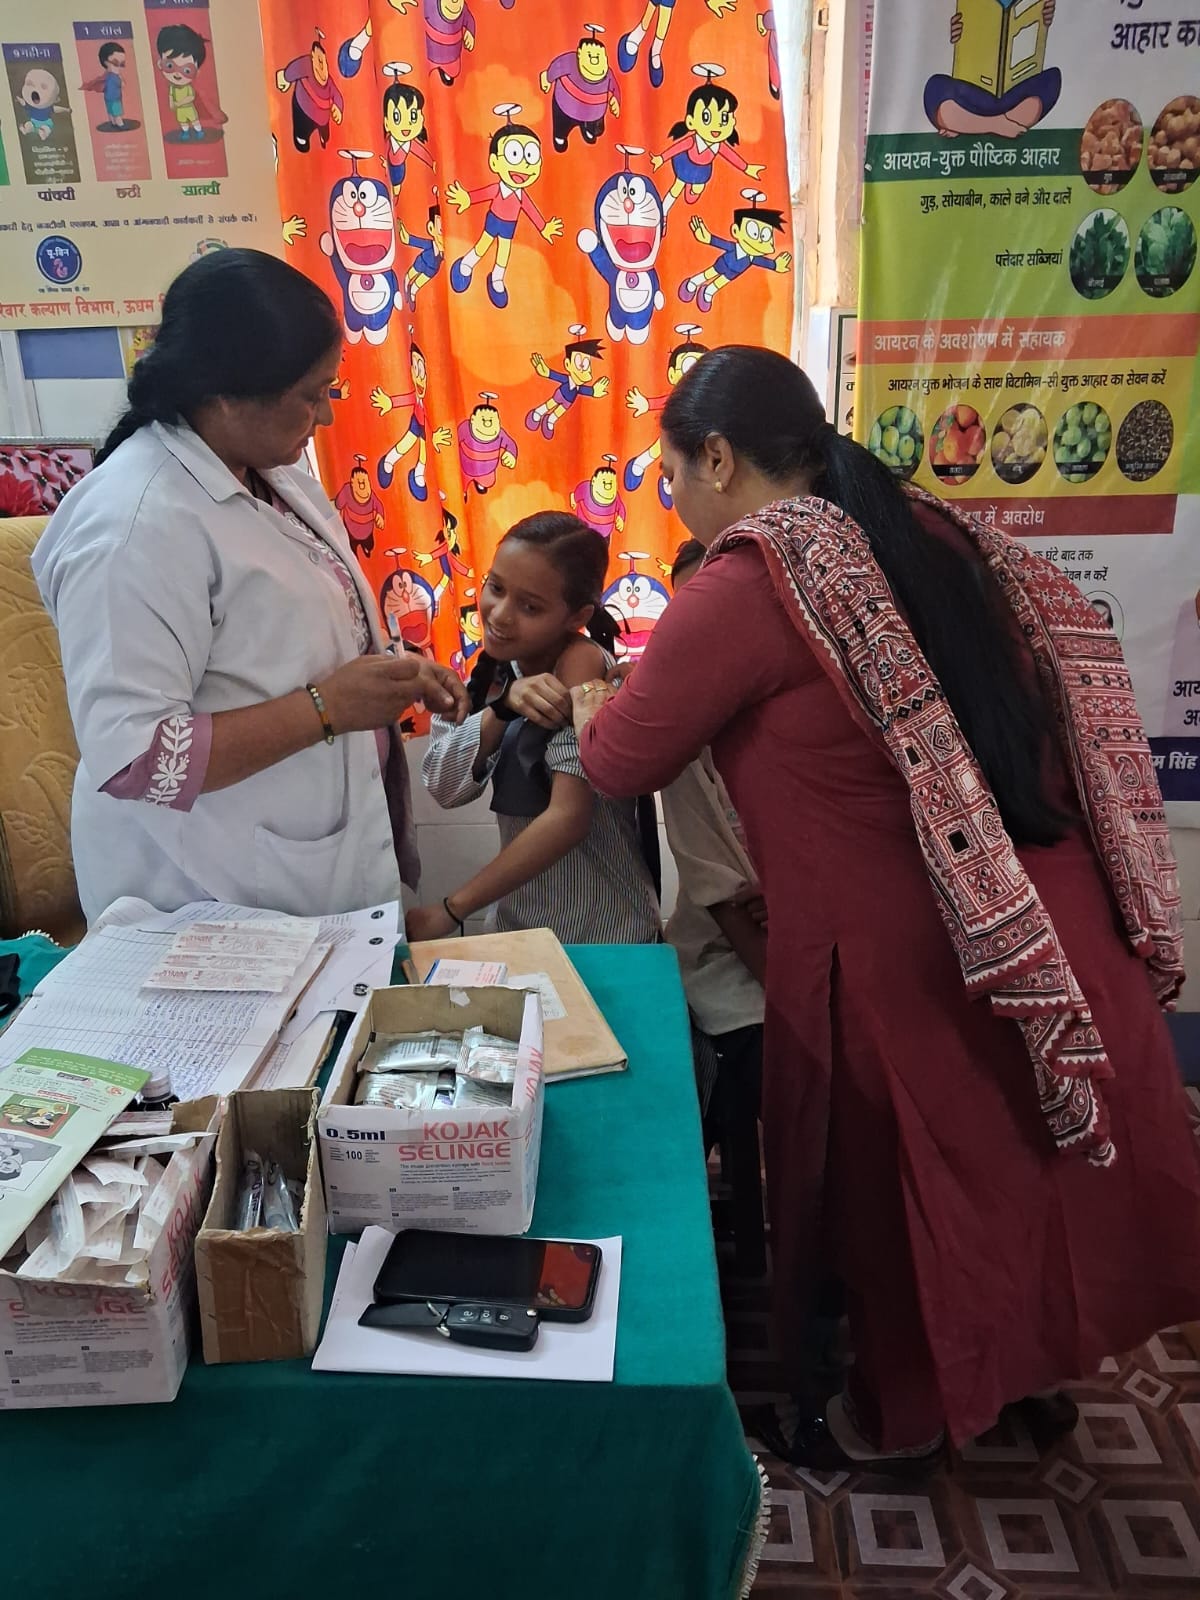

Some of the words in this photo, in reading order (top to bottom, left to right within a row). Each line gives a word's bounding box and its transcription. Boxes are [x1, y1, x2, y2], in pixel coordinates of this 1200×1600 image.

[100, 26, 122, 36] साल
[1110, 21, 1172, 54] आहार
[882, 150, 966, 176] आयरन-युक्त
[969, 142, 1018, 168] पौष्टिक
[1020, 148, 1061, 168] आहार
[920, 194, 939, 214] गुड़,
[990, 188, 1012, 207] काले
[1015, 188, 1030, 206] चने
[1032, 186, 1051, 206] और
[1053, 186, 1073, 205] दालें
[996, 250, 1024, 267] पत्तेदार
[29, 301, 71, 318] कल्याण
[74, 296, 121, 317] विभाग,
[123, 298, 154, 313] ऊधम
[874, 333, 920, 351] आयरन
[921, 328, 936, 350] के
[939, 326, 998, 350] अवशोषण
[1001, 325, 1014, 348] में
[1018, 330, 1067, 348] सहायक
[888, 378, 920, 392] आयरन
[921, 377, 940, 396] युक्त
[942, 373, 970, 391] भोजन
[971, 373, 982, 390] के
[984, 376, 1003, 389] साथ
[1061, 375, 1079, 393] युक्त
[1081, 374, 1108, 389] आहार
[1110, 373, 1124, 386] का
[1126, 369, 1149, 386] सेवन
[1150, 369, 1167, 385] करें
[984, 504, 998, 525] में
[1002, 504, 1045, 526] अवरोध
[1061, 549, 1076, 561] बाद
[1078, 549, 1094, 561] तक
[1083, 570, 1092, 581] न
[1093, 566, 1109, 581] करें
[1183, 709, 1200, 726] अ
[1169, 751, 1199, 770] सिंह
[326, 1128, 386, 1141] 0.5ml
[423, 1121, 510, 1141] KOJAK
[346, 1150, 363, 1160] 100
[398, 1142, 511, 1162] SELINGE
